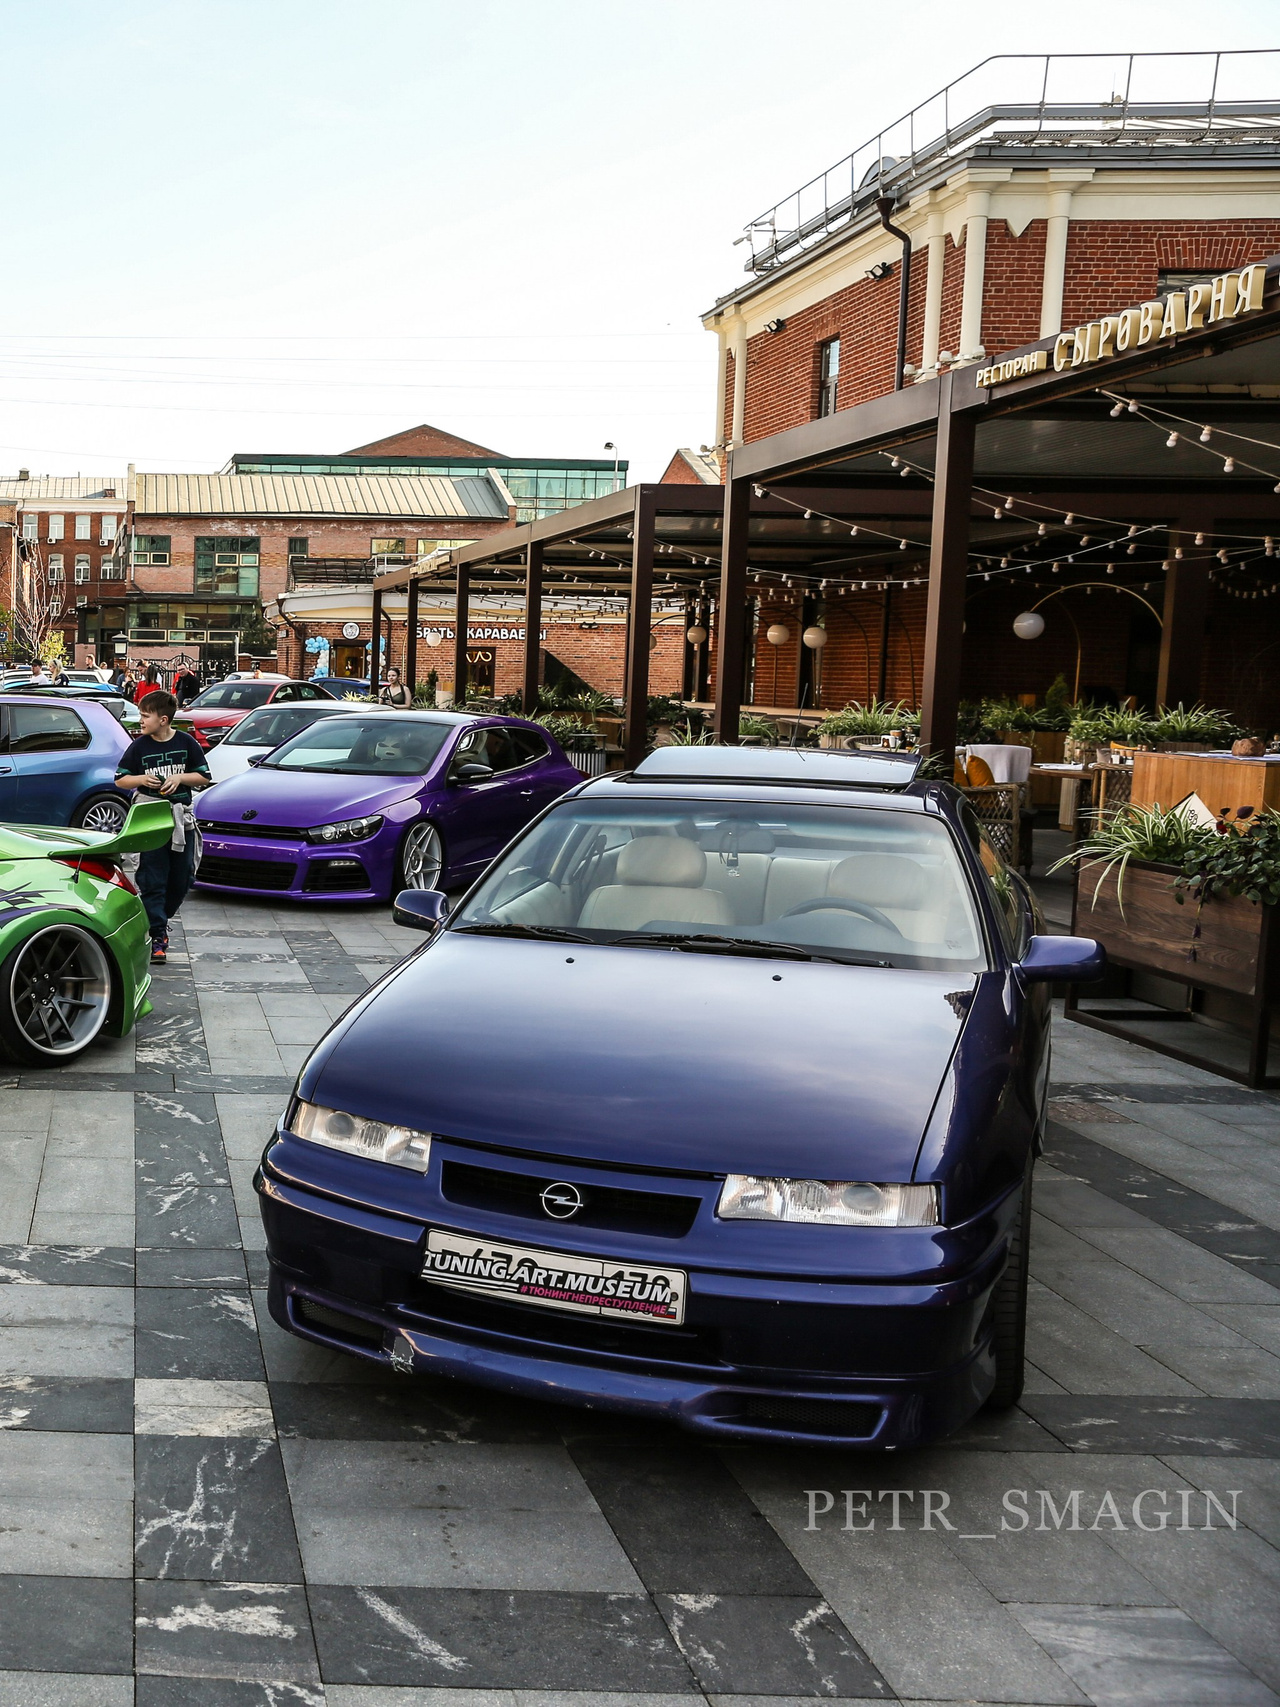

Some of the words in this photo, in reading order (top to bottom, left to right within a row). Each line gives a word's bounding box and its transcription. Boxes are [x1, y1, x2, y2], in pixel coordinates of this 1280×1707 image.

[976, 351, 1048, 388] РЕСТОРАН
[1053, 264, 1268, 373] СЫРОВАРНЯ
[467, 627, 547, 640] КАРАВАЕЫ
[424, 1250, 671, 1303] TUNING.ART.MUSEUM
[520, 1285, 668, 1315] #ТЮНИНГНЕПРЕСТУПЛЕНИЕ
